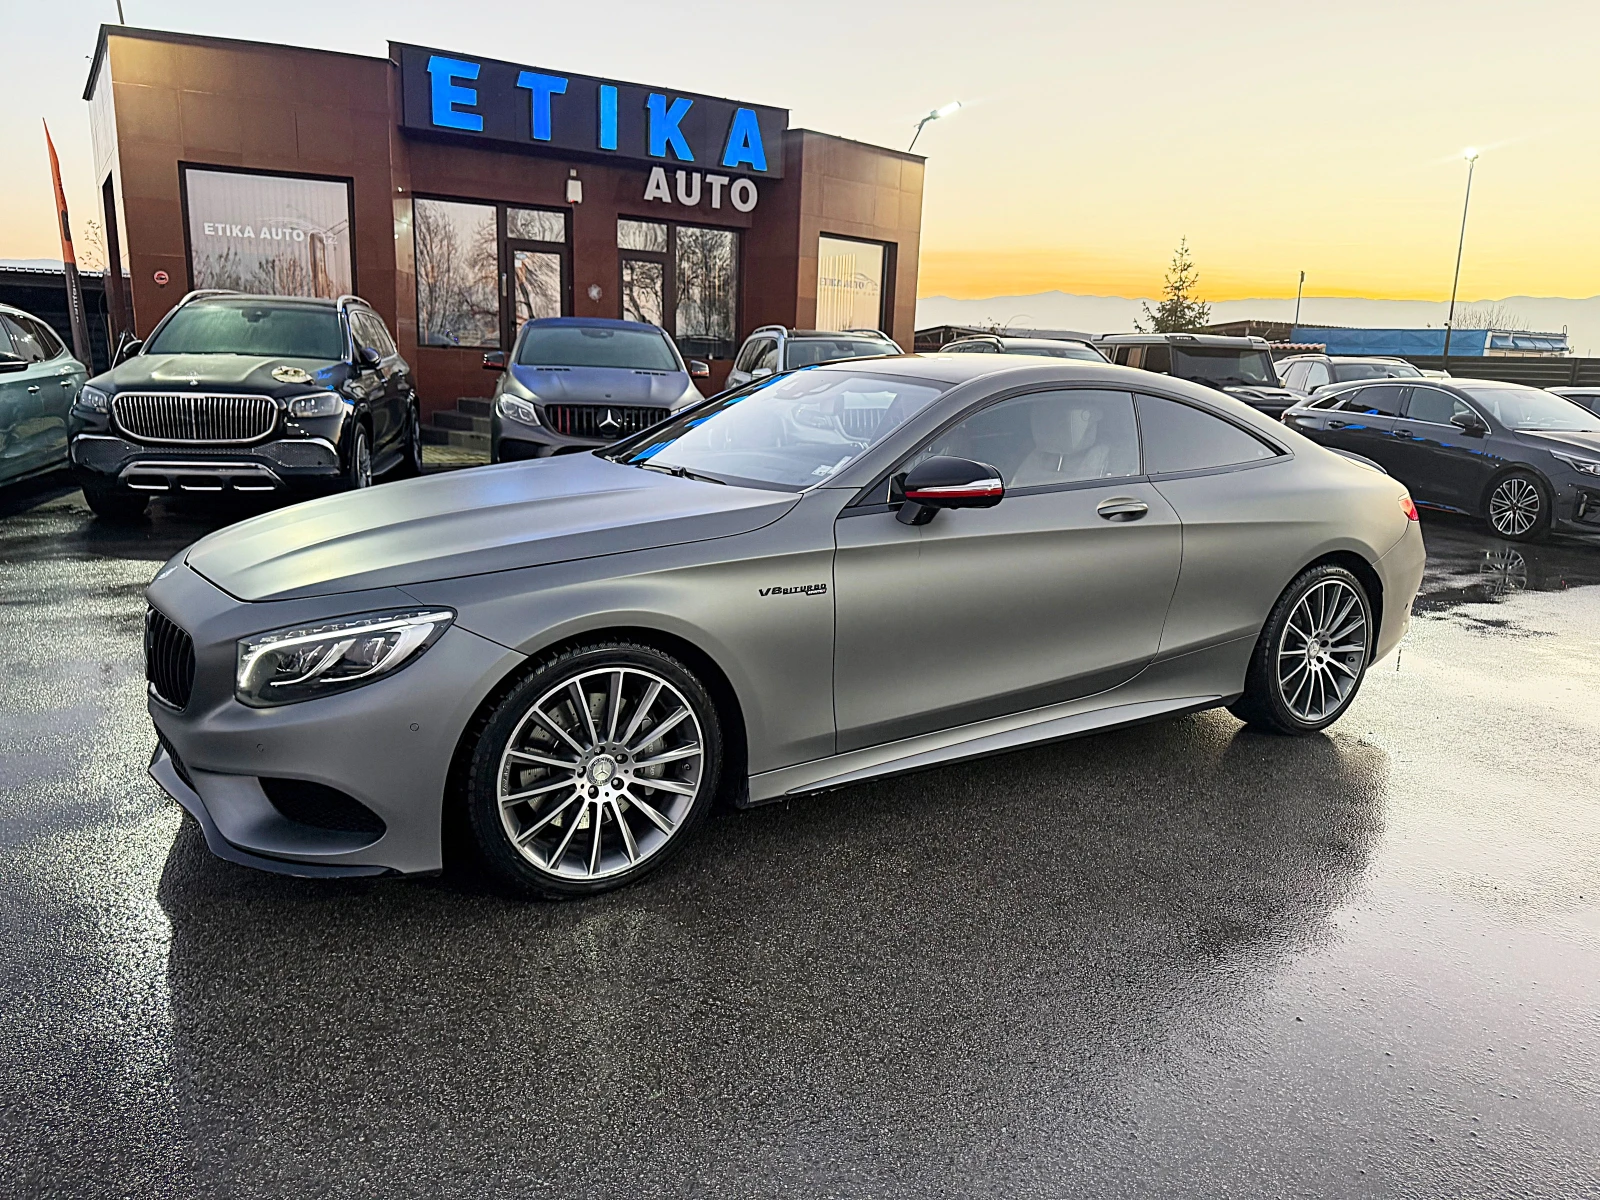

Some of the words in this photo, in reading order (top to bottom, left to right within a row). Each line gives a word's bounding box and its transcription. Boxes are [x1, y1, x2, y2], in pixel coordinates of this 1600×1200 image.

[427, 55, 768, 172] ETIKA
[644, 166, 759, 212] AUTO
[204, 222, 255, 238] ETIKA
[260, 227, 305, 241] AUTO
